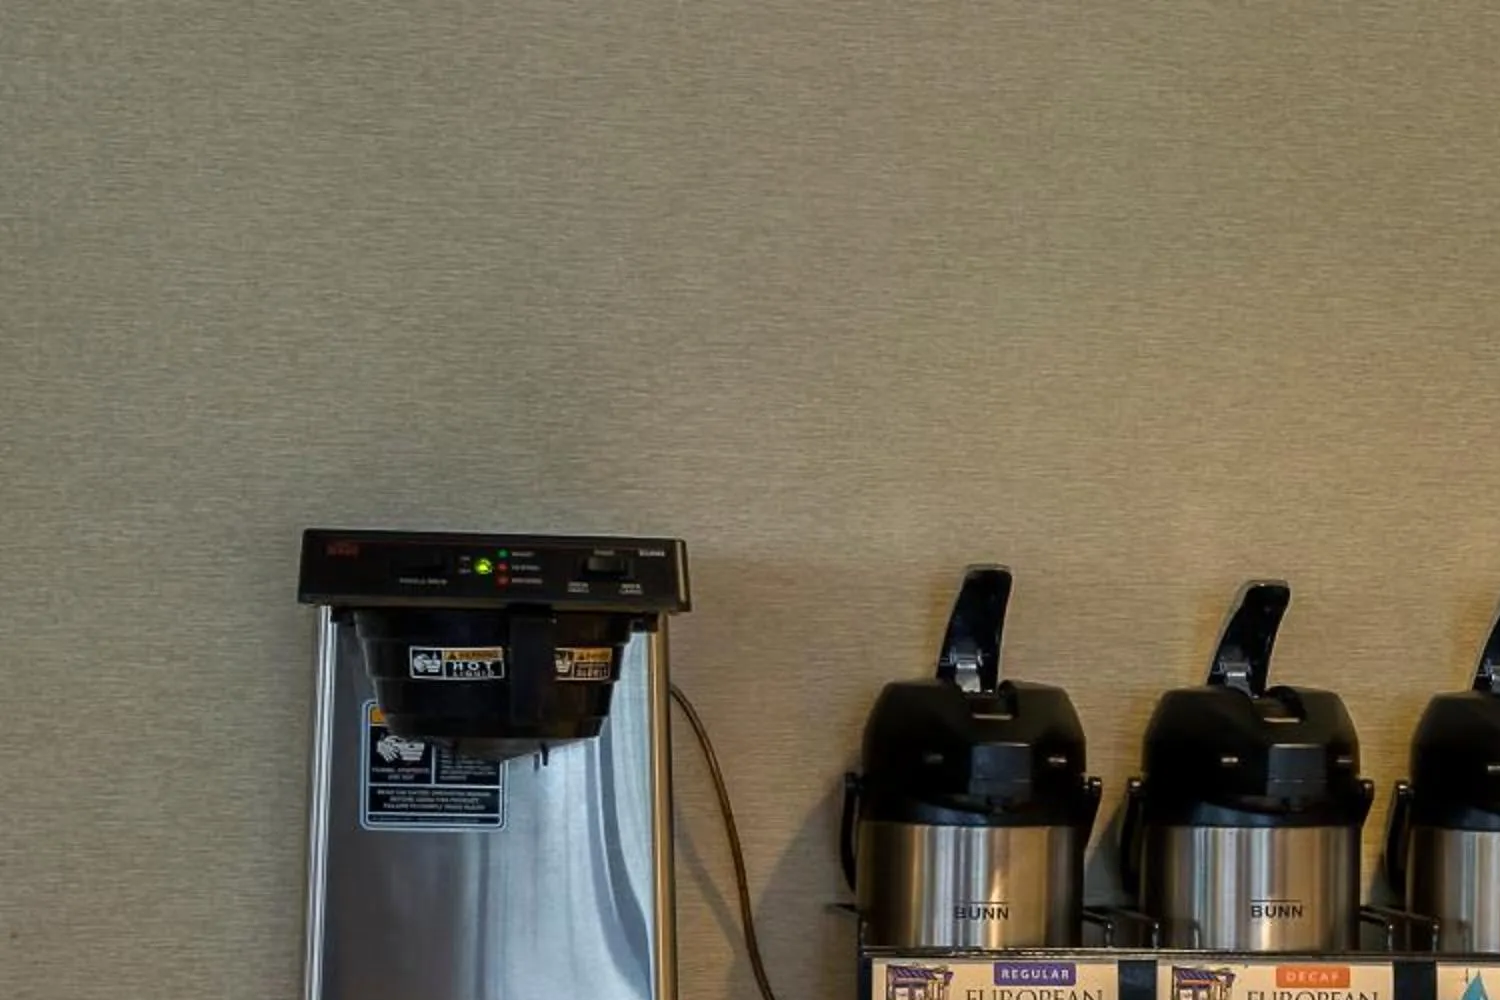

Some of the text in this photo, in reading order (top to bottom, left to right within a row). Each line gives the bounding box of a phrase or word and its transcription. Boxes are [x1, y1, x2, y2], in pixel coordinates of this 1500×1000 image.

[954, 906, 1009, 921] BUNN
[1250, 904, 1304, 919] BUNN
[1001, 969, 1070, 979] REGULAR
[1286, 972, 1340, 983] DECAF
